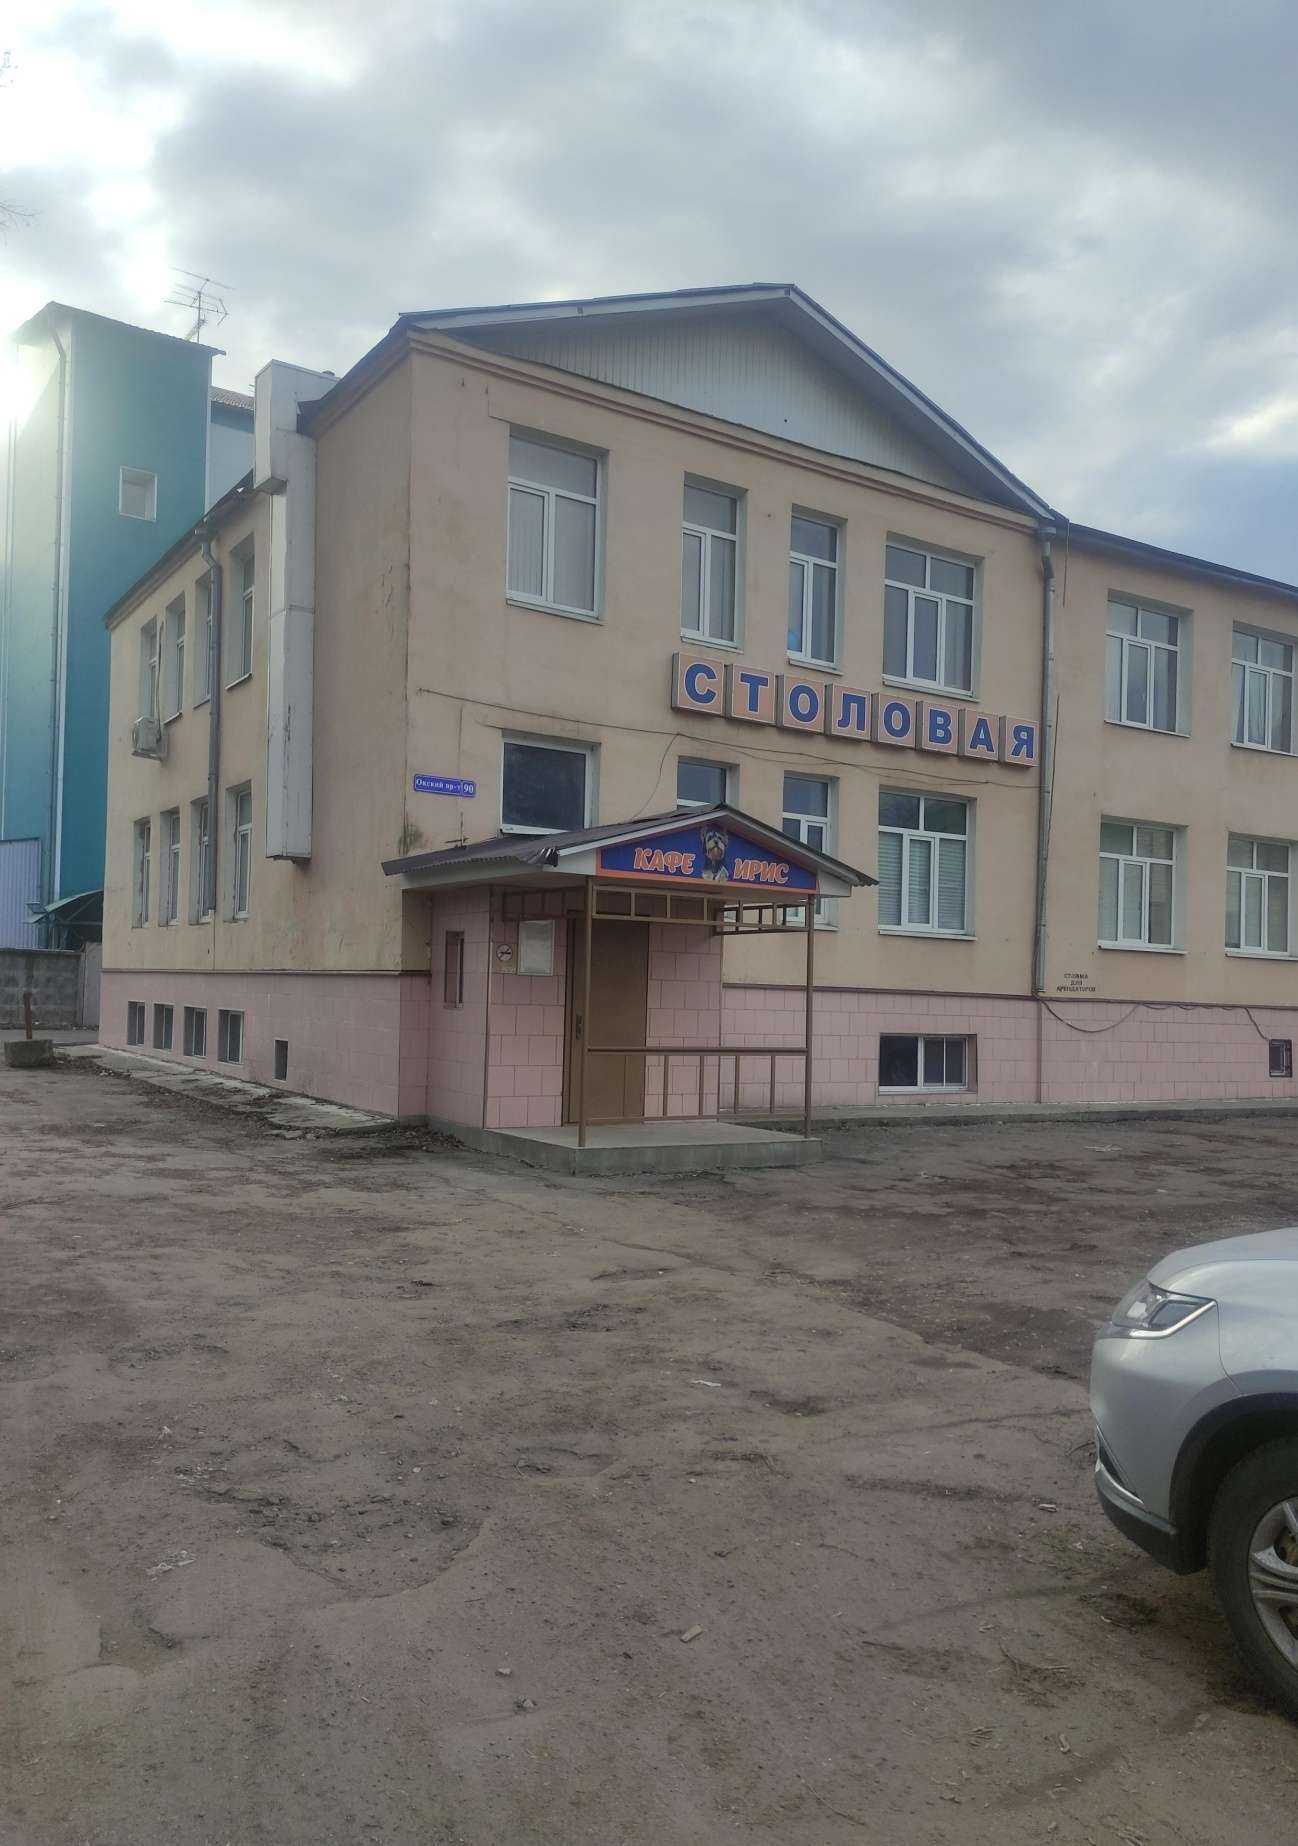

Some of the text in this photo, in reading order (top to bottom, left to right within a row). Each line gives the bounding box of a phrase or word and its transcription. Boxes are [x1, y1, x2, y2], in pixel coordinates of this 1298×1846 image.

[683, 662, 1035, 760] СТОЛОВАЯ
[416, 778, 444, 789] Окский
[463, 784, 474, 794] 90
[633, 847, 790, 884] КАФЕ ИРИС
